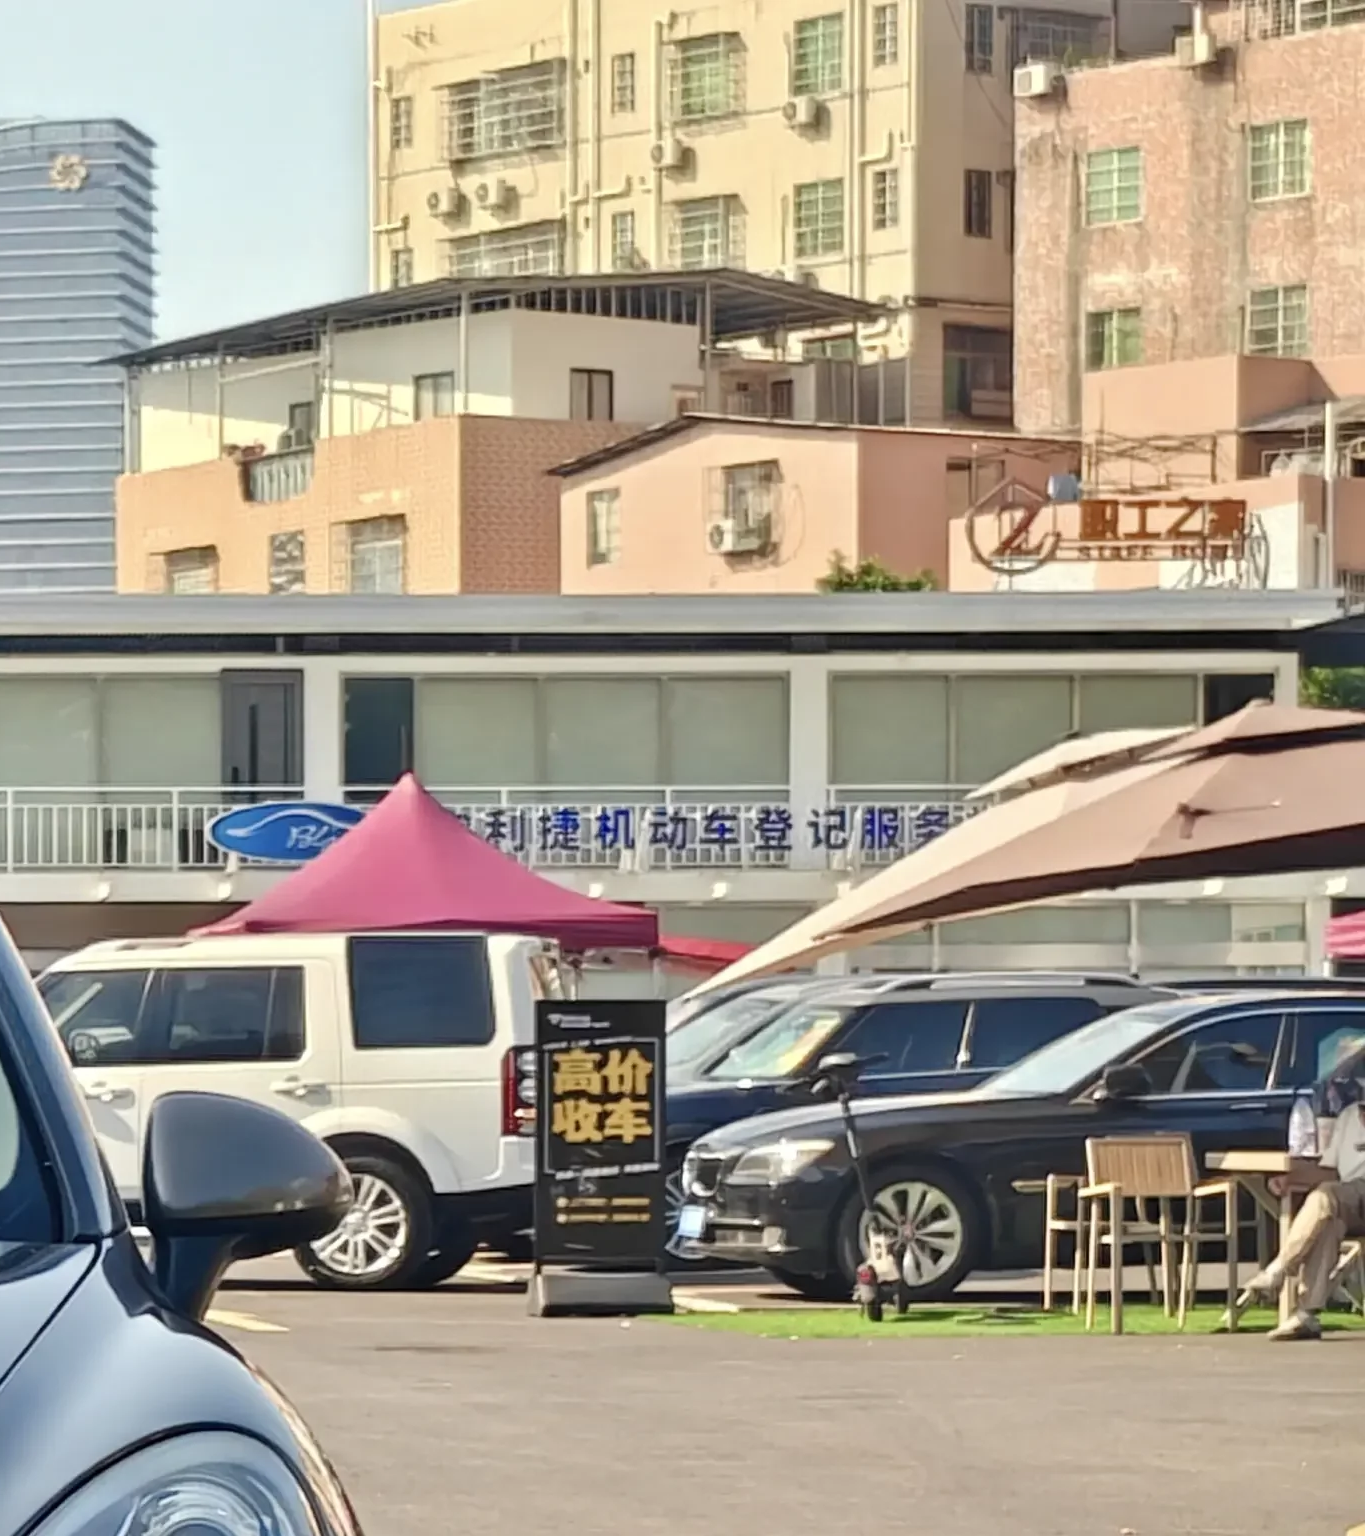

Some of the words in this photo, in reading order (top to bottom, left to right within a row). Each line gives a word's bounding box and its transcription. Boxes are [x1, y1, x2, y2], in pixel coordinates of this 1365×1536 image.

[455, 807, 988, 851] 利捷机动车登记服务
[552, 1049, 652, 1095] 高价
[552, 1097, 652, 1143] 收车
